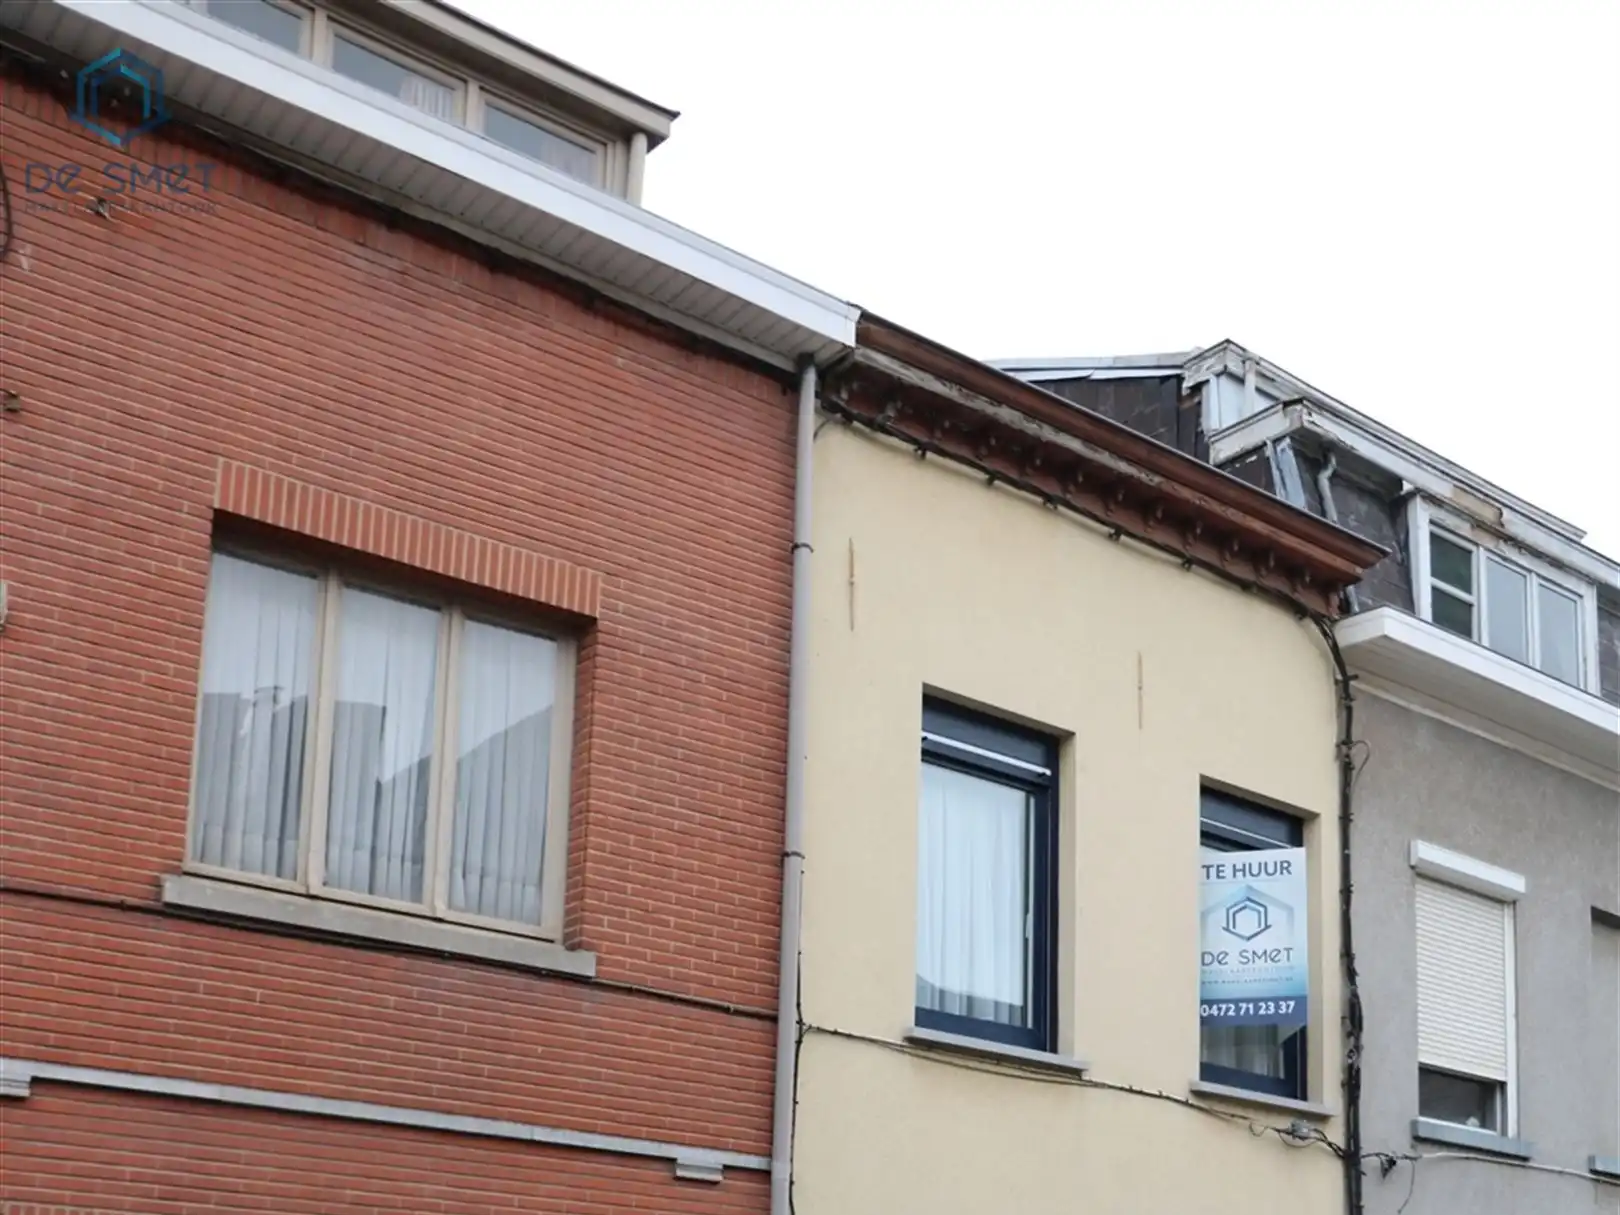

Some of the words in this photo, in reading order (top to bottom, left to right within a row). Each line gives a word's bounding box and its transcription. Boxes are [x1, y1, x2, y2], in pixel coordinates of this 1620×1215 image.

[1201, 864, 1226, 880] TE
[1232, 860, 1292, 878] HUUR
[1200, 1004, 1236, 1016] 0472
[1239, 1002, 1254, 1015] 71
[1258, 1001, 1275, 1015] 23
[1278, 1000, 1295, 1014] 37
